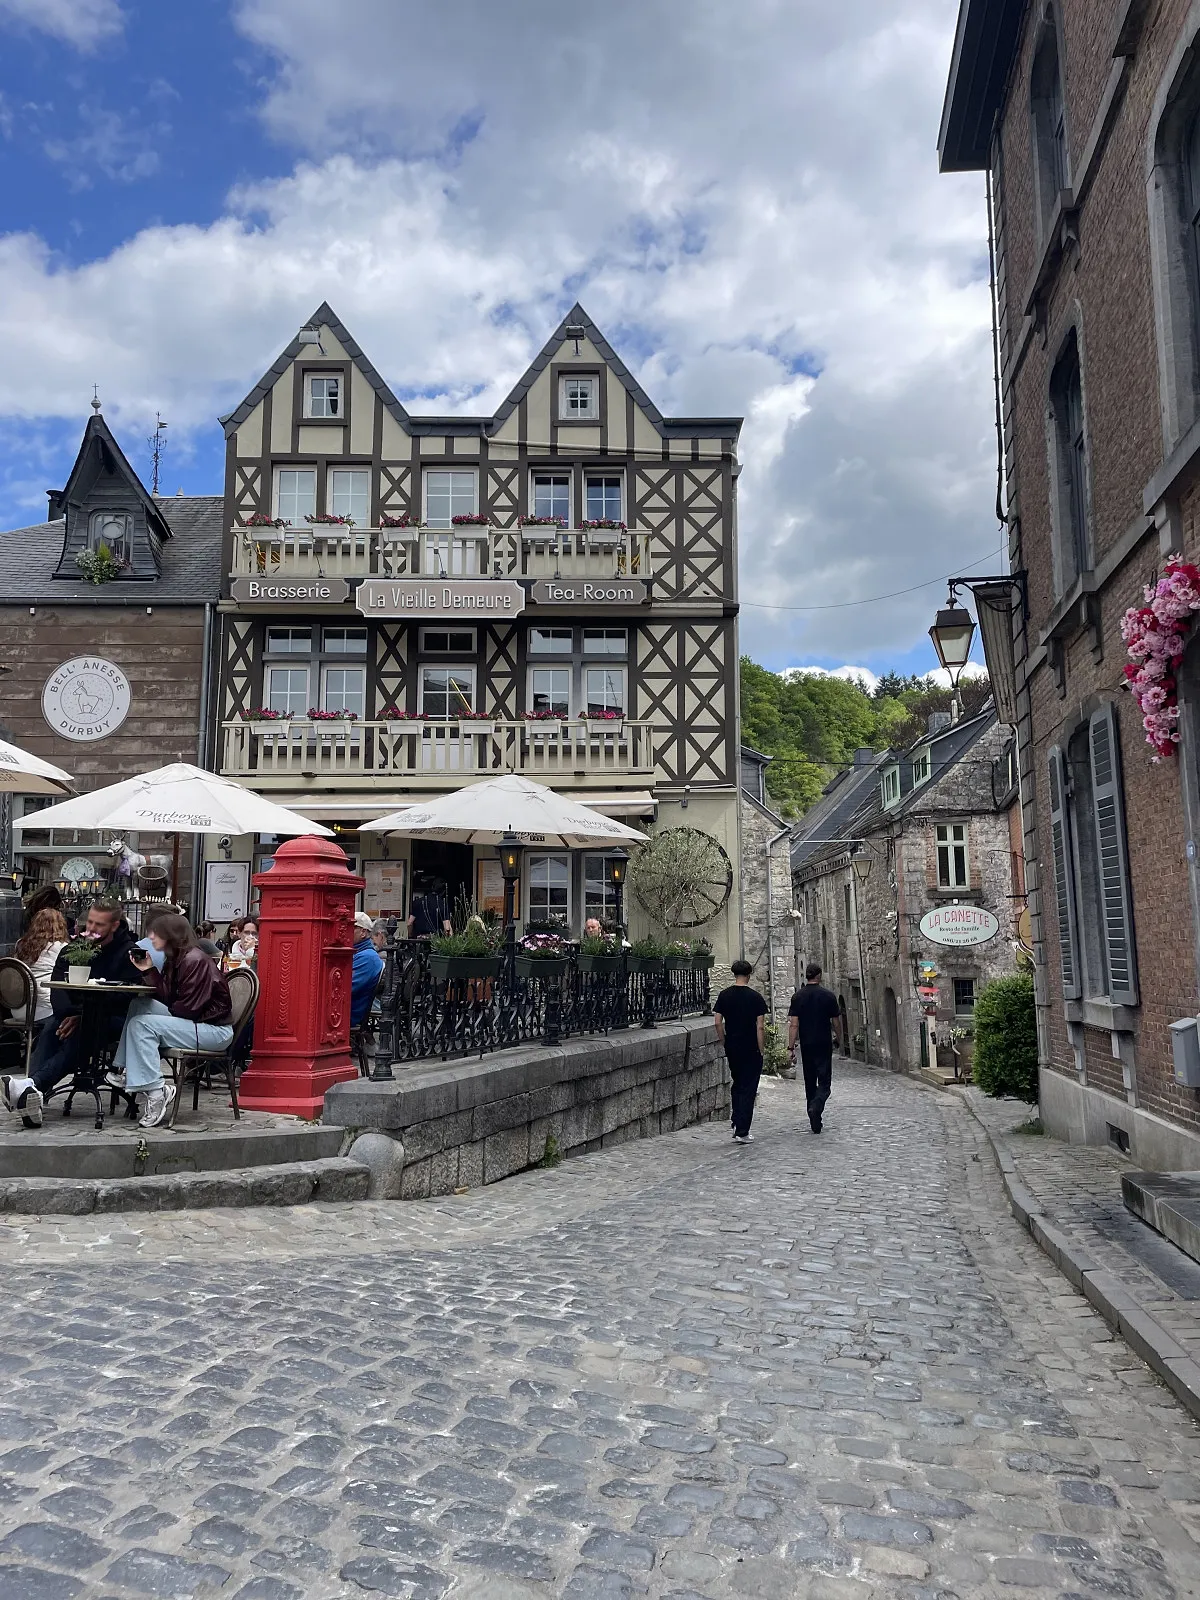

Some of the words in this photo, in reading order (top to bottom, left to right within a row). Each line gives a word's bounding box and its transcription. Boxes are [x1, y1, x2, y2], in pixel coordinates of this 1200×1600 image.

[249, 581, 331, 598] Brasserie
[368, 587, 386, 608] La
[391, 587, 437, 609] Vieille
[442, 587, 512, 609] Demeure
[544, 582, 635, 601] Tea-Room
[83, 659, 125, 692] ÂNESSE
[60, 720, 111, 736] DURBUY
[220, 902, 233, 910] 1967
[929, 913, 941, 929] LA
[944, 908, 990, 929] CANETTE
